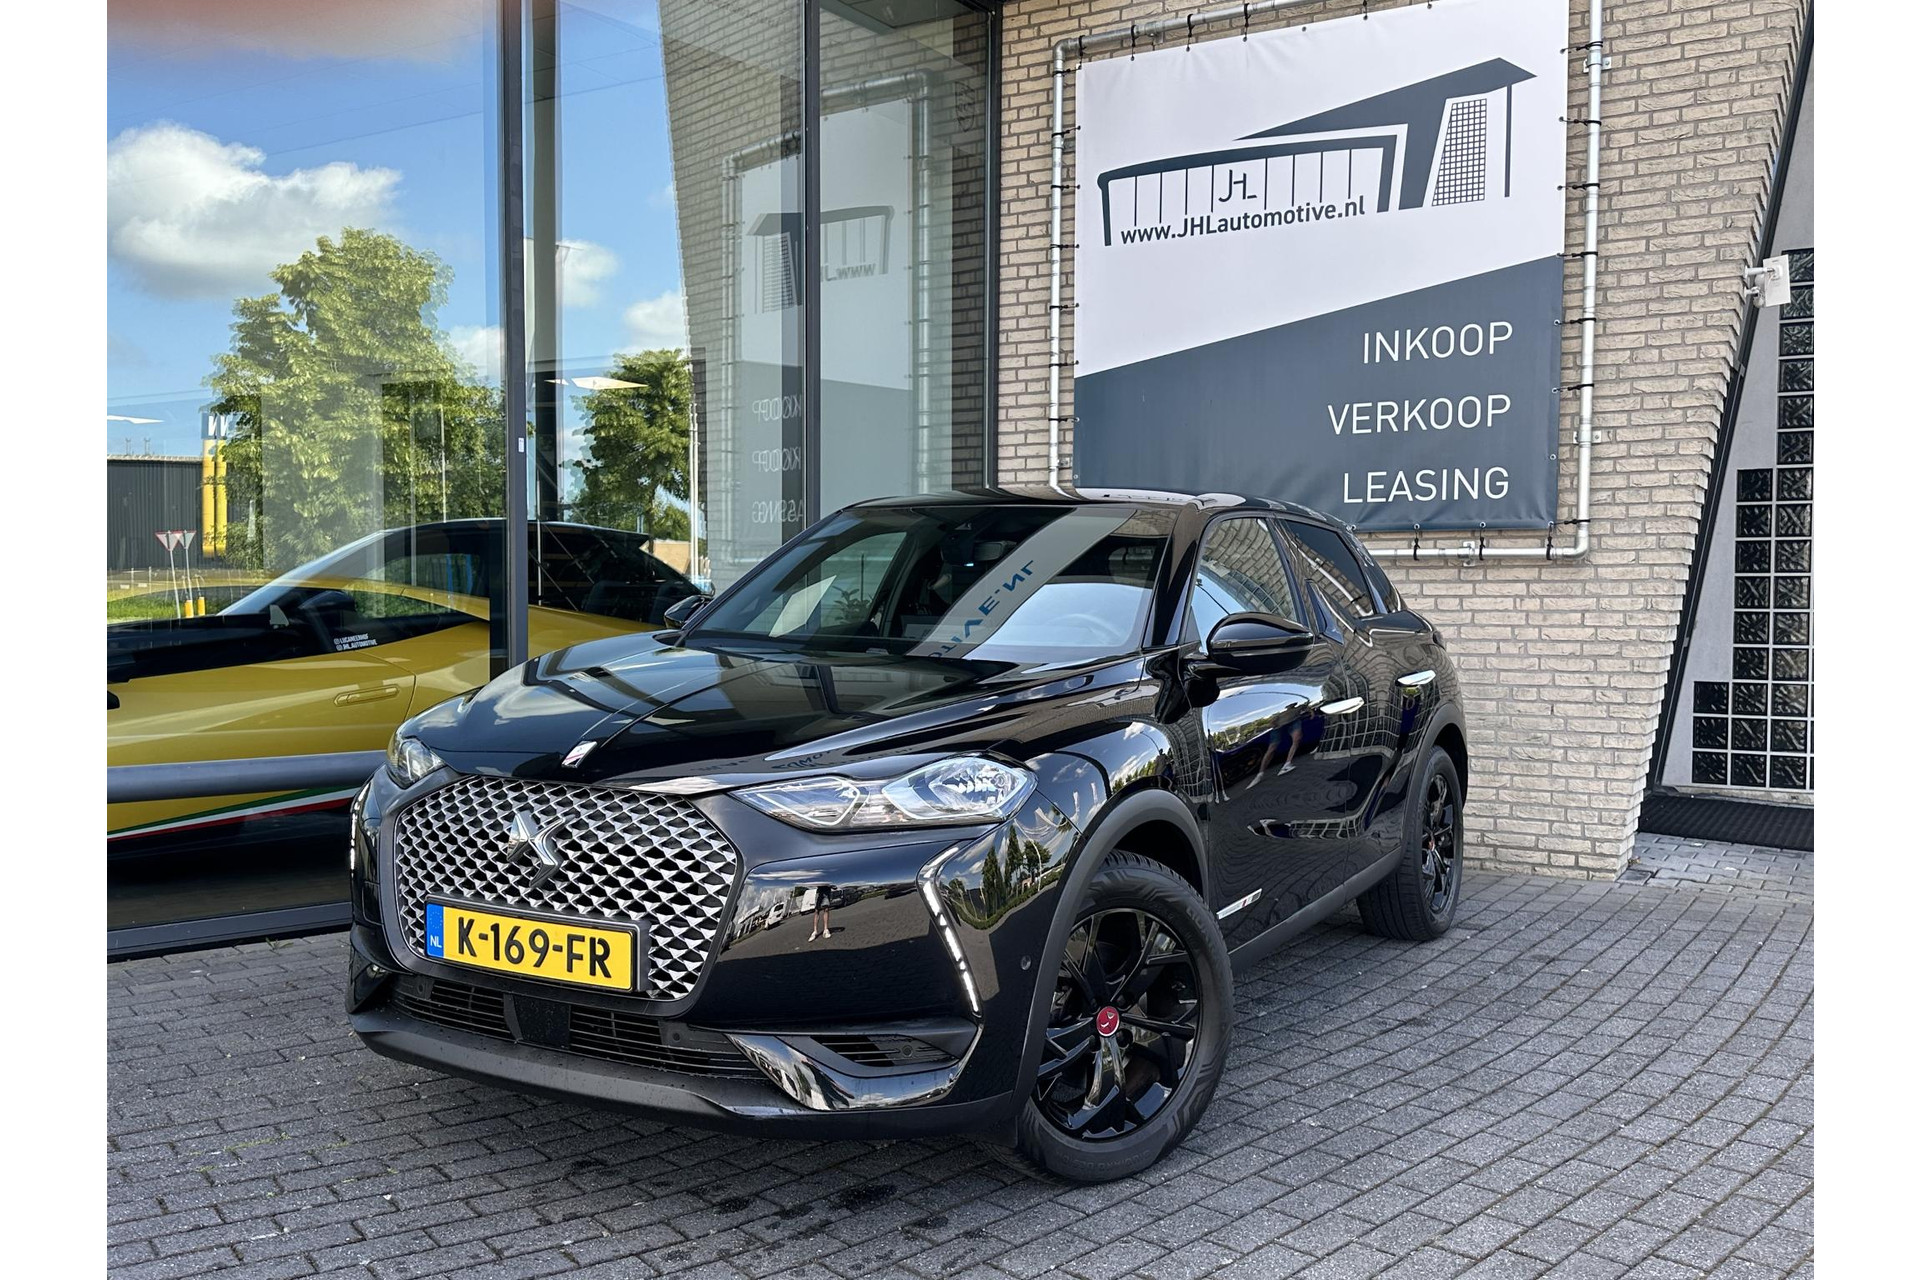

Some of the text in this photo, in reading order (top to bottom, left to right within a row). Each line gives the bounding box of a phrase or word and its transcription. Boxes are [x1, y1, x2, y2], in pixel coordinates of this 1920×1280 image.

[1217, 169, 1258, 203] JHL
[1120, 195, 1366, 245] www.JHLautomotive.nl
[1363, 321, 1513, 364] INKOOP
[1327, 394, 1511, 436] VERKOOP
[1343, 466, 1510, 504] LEASING
[429, 935, 443, 949] NL
[457, 916, 612, 979] K-169-FR
